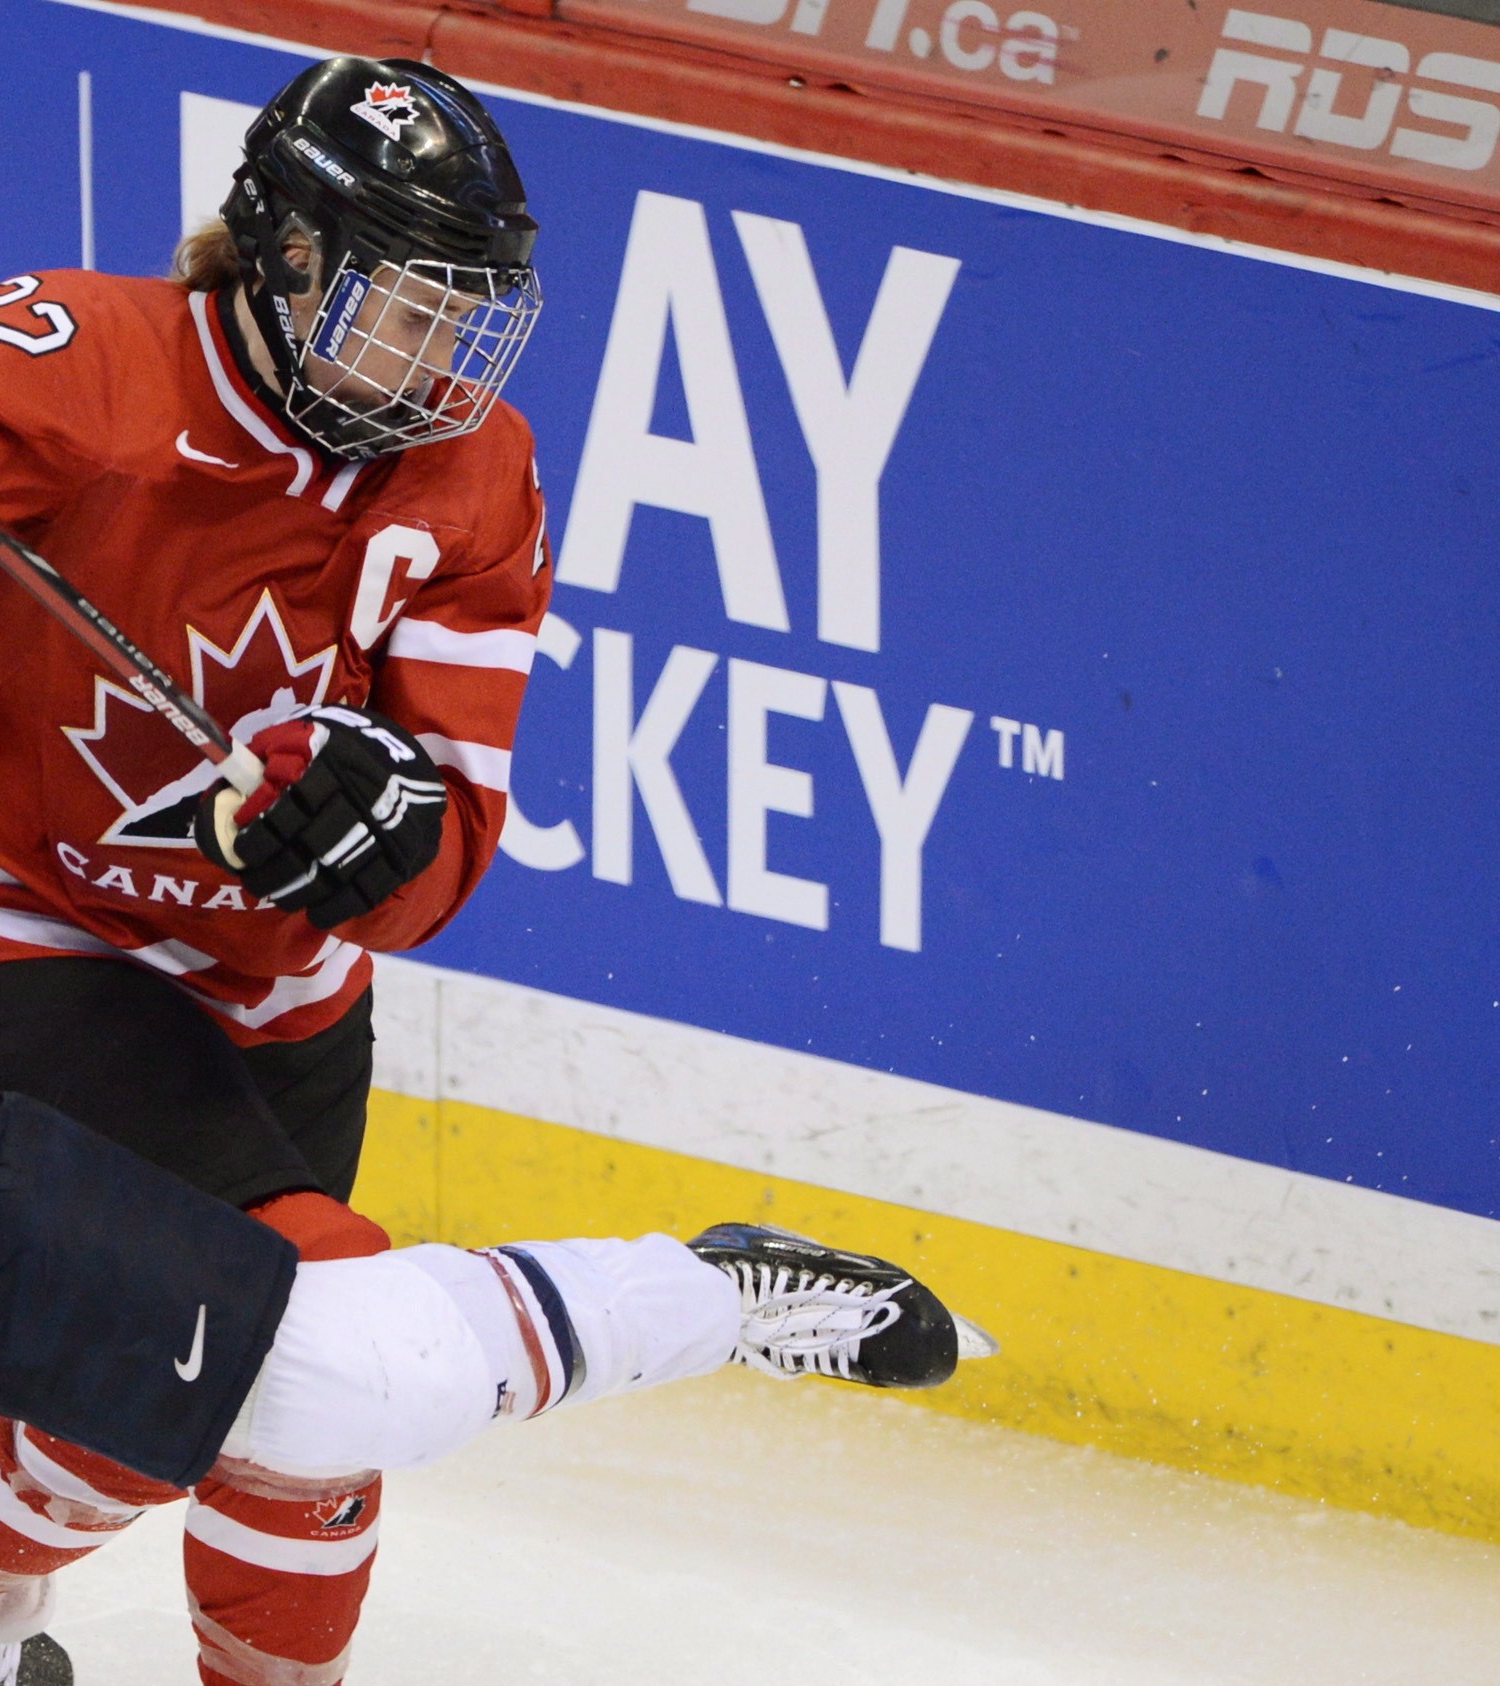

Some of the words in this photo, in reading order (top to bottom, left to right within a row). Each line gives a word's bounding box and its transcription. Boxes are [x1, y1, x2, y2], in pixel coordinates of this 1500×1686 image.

[1196, 8, 1500, 171] RDS
[292, 137, 356, 187] BAUER
[325, 280, 366, 358] BAUER
[350, 524, 441, 649] C
[128, 674, 210, 746] BAUER
[498, 610, 974, 953] CKEY
